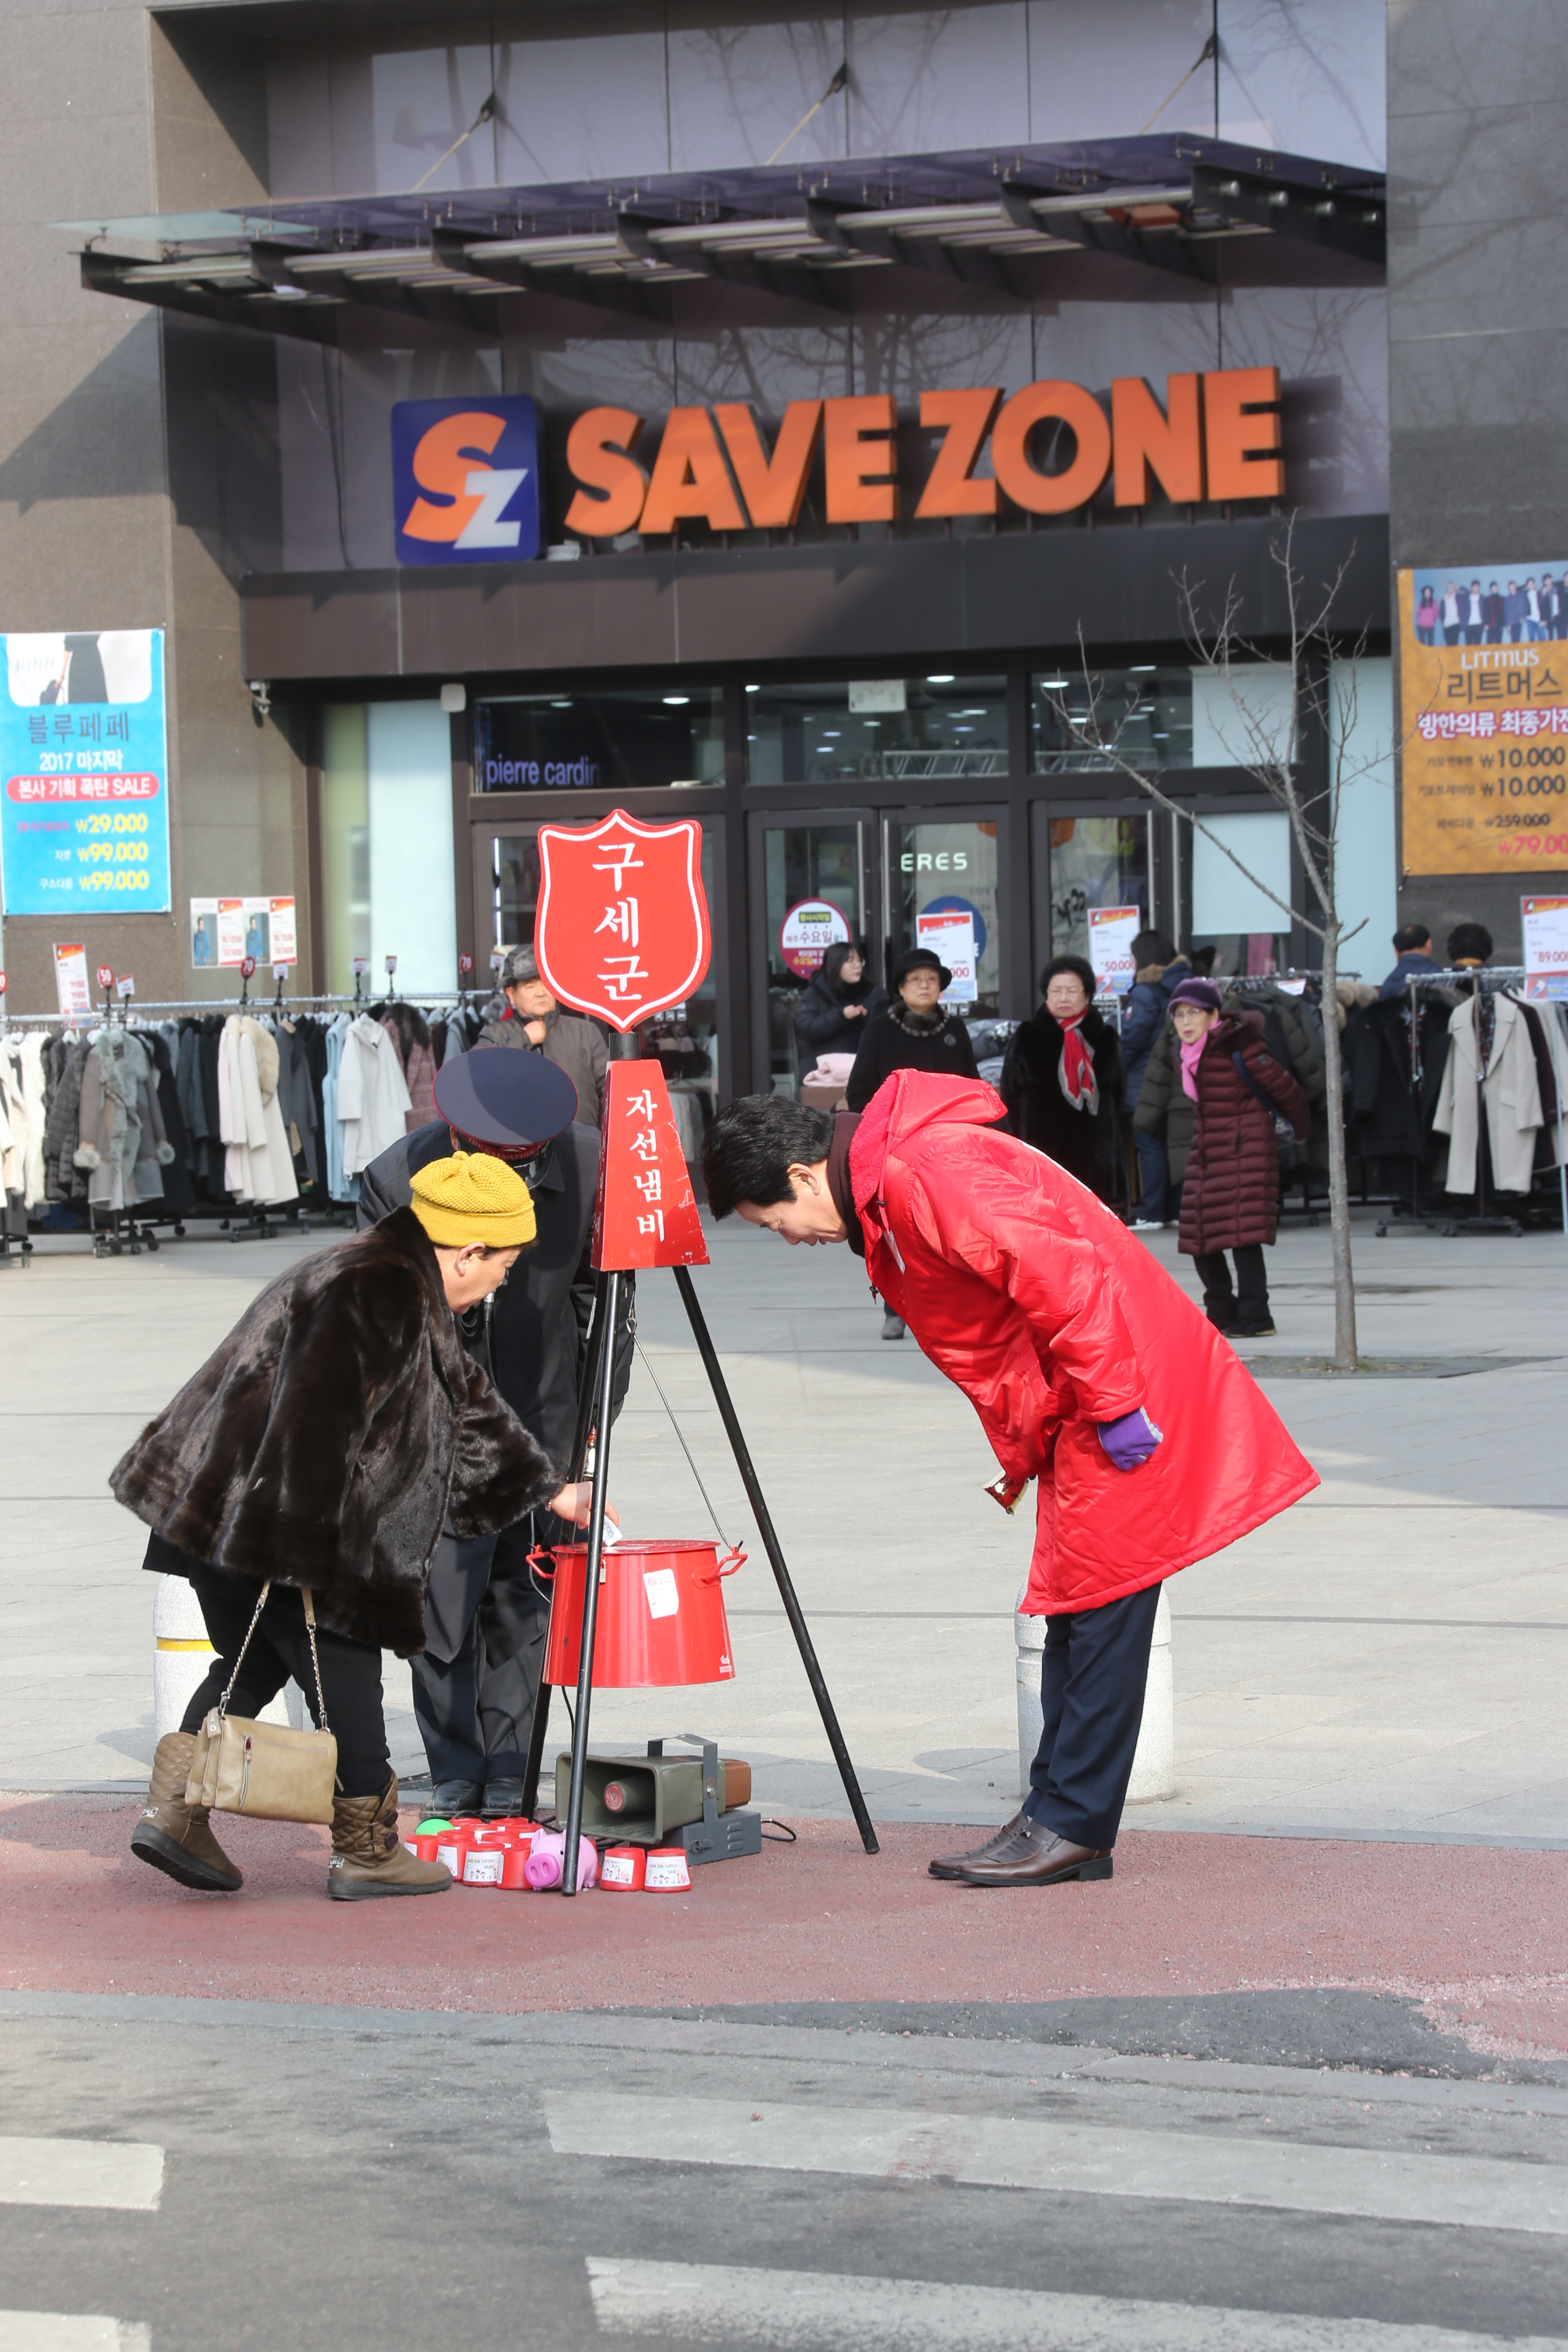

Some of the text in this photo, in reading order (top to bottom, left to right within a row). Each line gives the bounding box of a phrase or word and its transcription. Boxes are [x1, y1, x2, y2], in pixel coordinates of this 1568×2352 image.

[564, 365, 1285, 537] SAVE ZONE
[1448, 666, 1562, 704] 리트머스
[29, 711, 129, 744] 블루페페
[1418, 711, 1497, 740] 방한의류
[39, 748, 124, 772] 2017 마지막
[486, 753, 599, 791] pierre cardin
[18, 777, 151, 799] 본사 기획 폭탄 SALE
[900, 852, 968, 872] ERES
[592, 843, 649, 1000] 구세군
[800, 931, 832, 943] 수요일
[100, 969, 112, 981] 50
[243, 960, 254, 972] 70
[625, 1090, 666, 1243] 자선냄비
